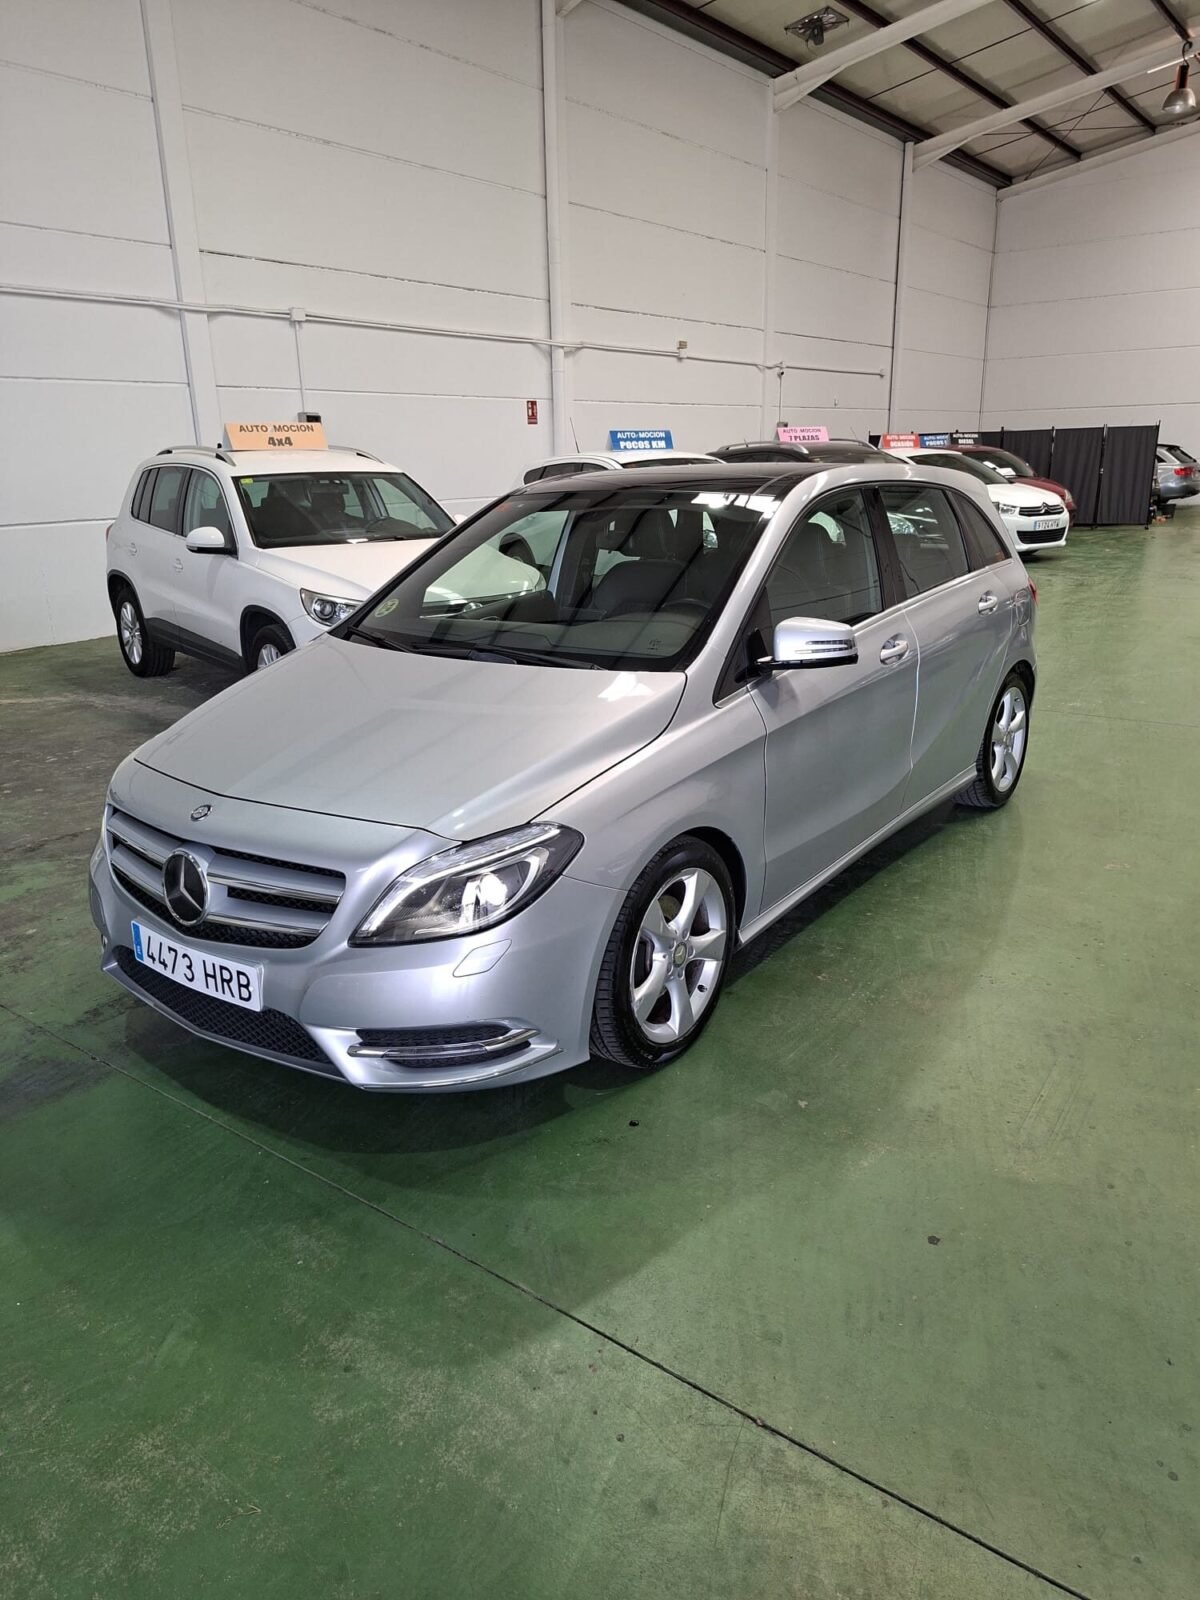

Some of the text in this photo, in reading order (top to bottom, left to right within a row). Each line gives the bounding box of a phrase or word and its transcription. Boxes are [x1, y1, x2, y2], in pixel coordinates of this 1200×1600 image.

[239, 424, 315, 433] AUTO MOCION
[617, 431, 636, 439] AUTO
[267, 436, 293, 447] 4x4
[619, 440, 667, 449] POCOS KM
[147, 936, 252, 1002] 4473 HRB
